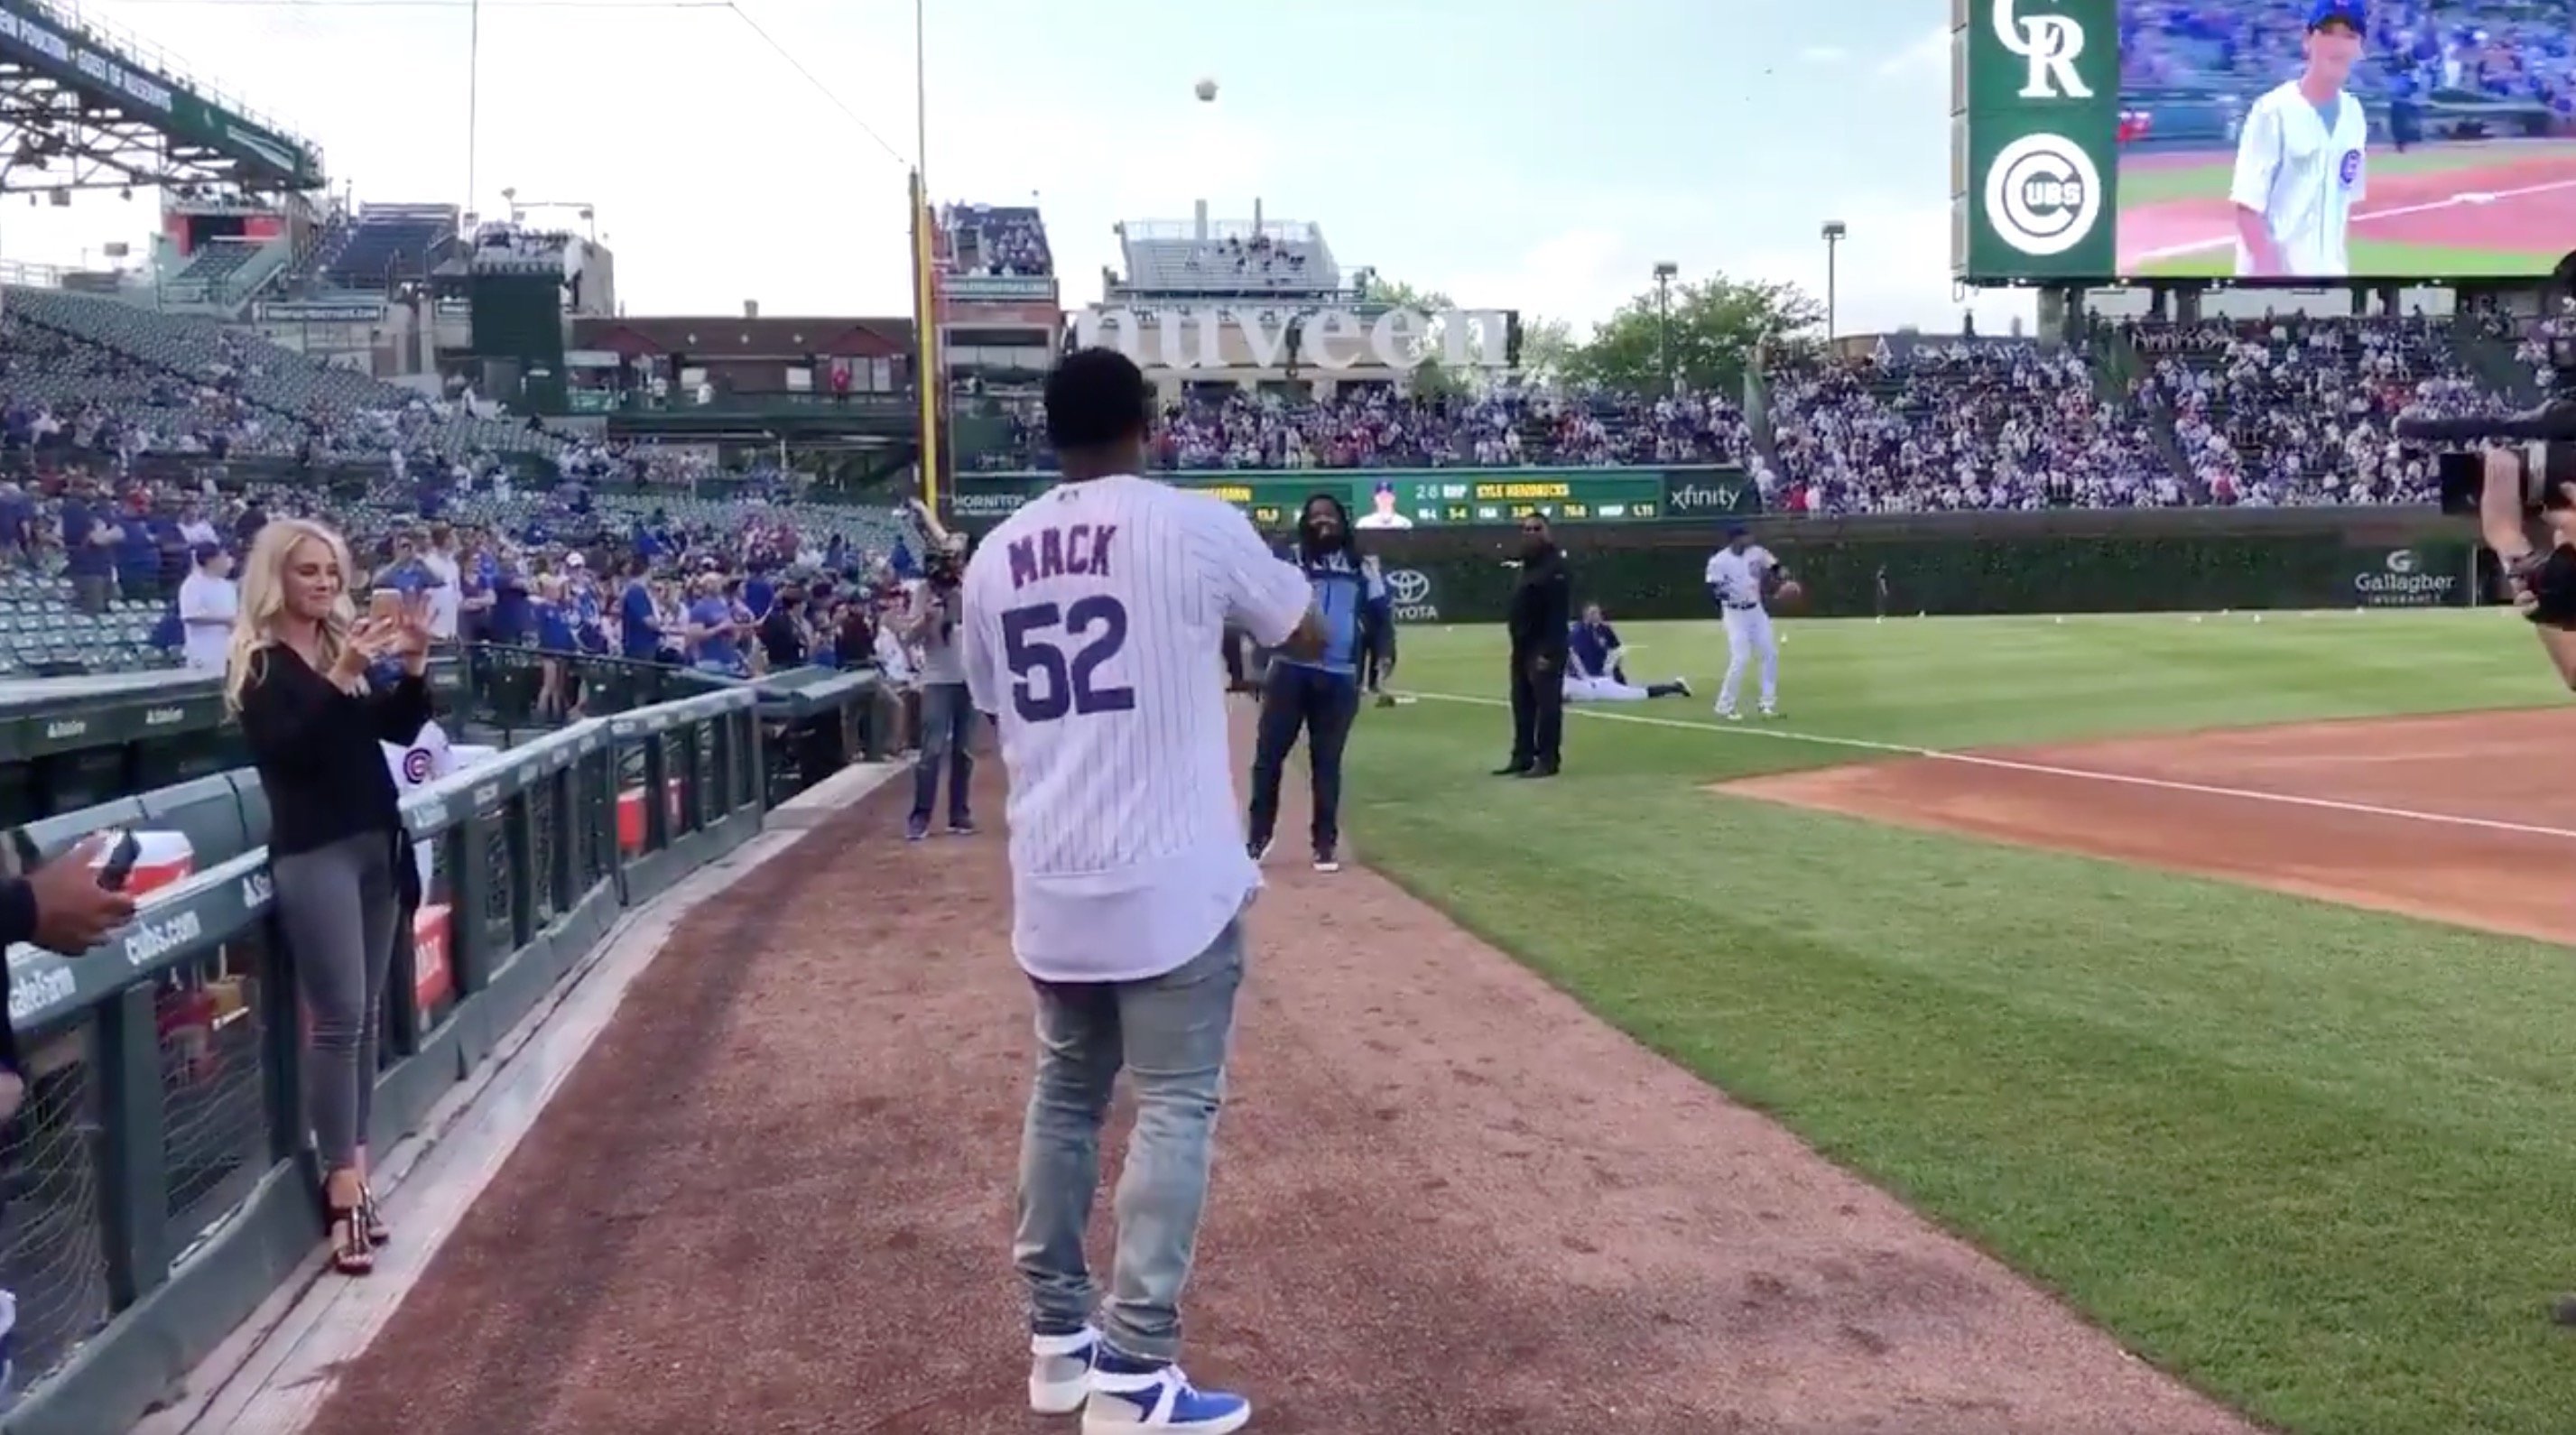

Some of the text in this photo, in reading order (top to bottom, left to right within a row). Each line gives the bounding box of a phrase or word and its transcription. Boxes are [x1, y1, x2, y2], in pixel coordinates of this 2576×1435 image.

[1077, 302, 1510, 369] nuveen
[1671, 483, 1740, 512] xfinity
[1007, 523, 1117, 591] MACK
[2354, 571, 2455, 594] Gallagher
[1395, 606, 1440, 620] YOTA
[1001, 594, 1135, 723] 52
